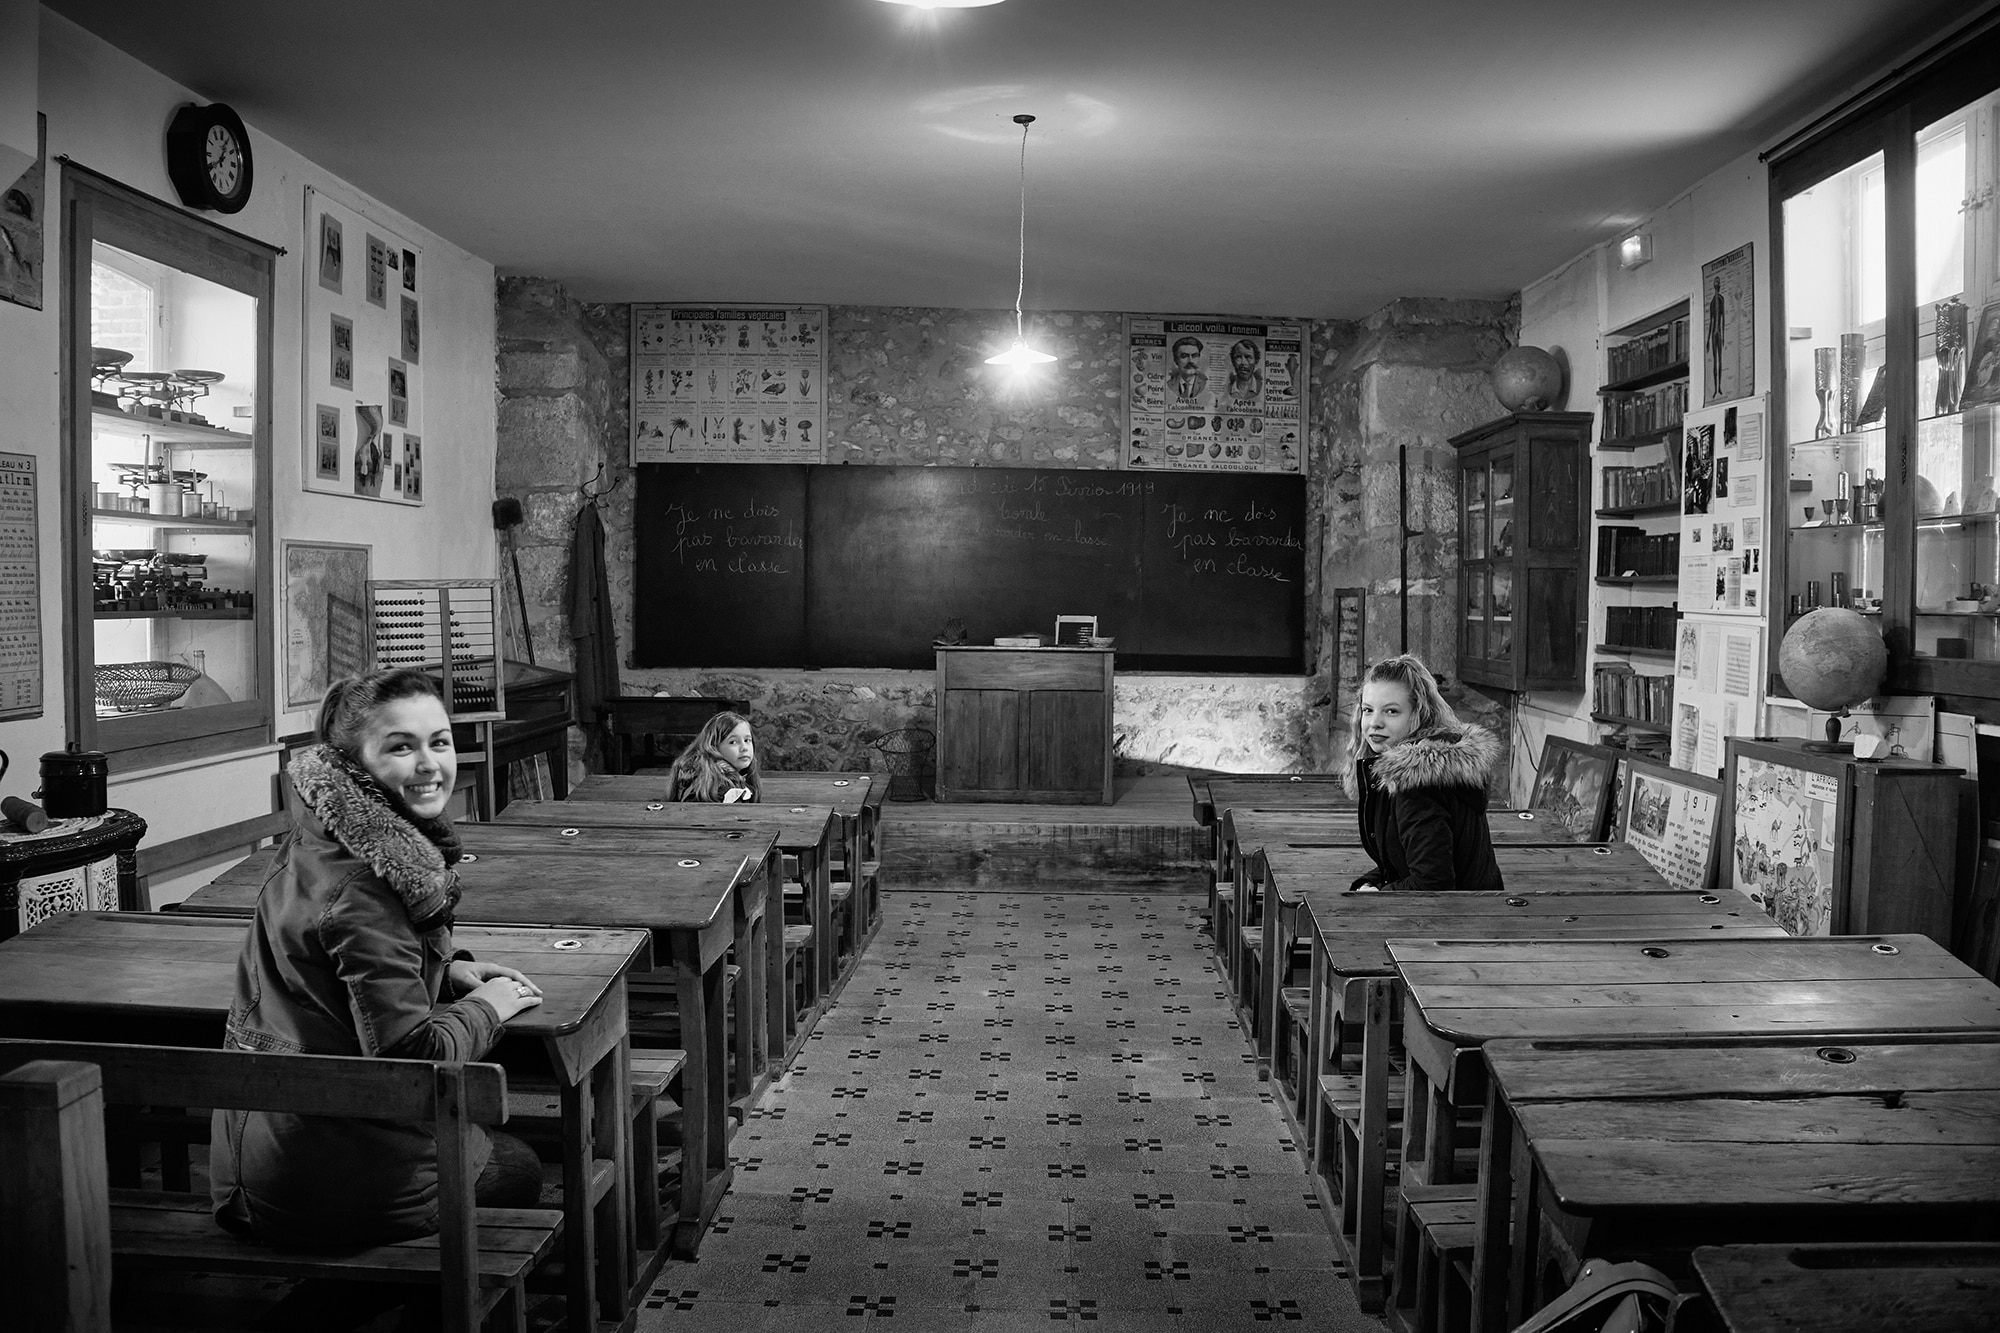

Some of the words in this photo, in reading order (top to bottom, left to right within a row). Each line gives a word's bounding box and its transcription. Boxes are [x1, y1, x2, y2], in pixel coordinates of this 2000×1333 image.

[665, 502, 700, 536] Je
[708, 507, 735, 520] ne
[743, 498, 780, 519] dois
[1161, 503, 1195, 539] Je
[1203, 509, 1234, 522] ne
[1244, 500, 1277, 521] dois
[671, 532, 713, 565] pas
[1173, 532, 1217, 560] pas
[695, 558, 718, 572] en
[728, 551, 789, 574] classe
[1193, 558, 1217, 573] en
[1226, 552, 1291, 582] classe
